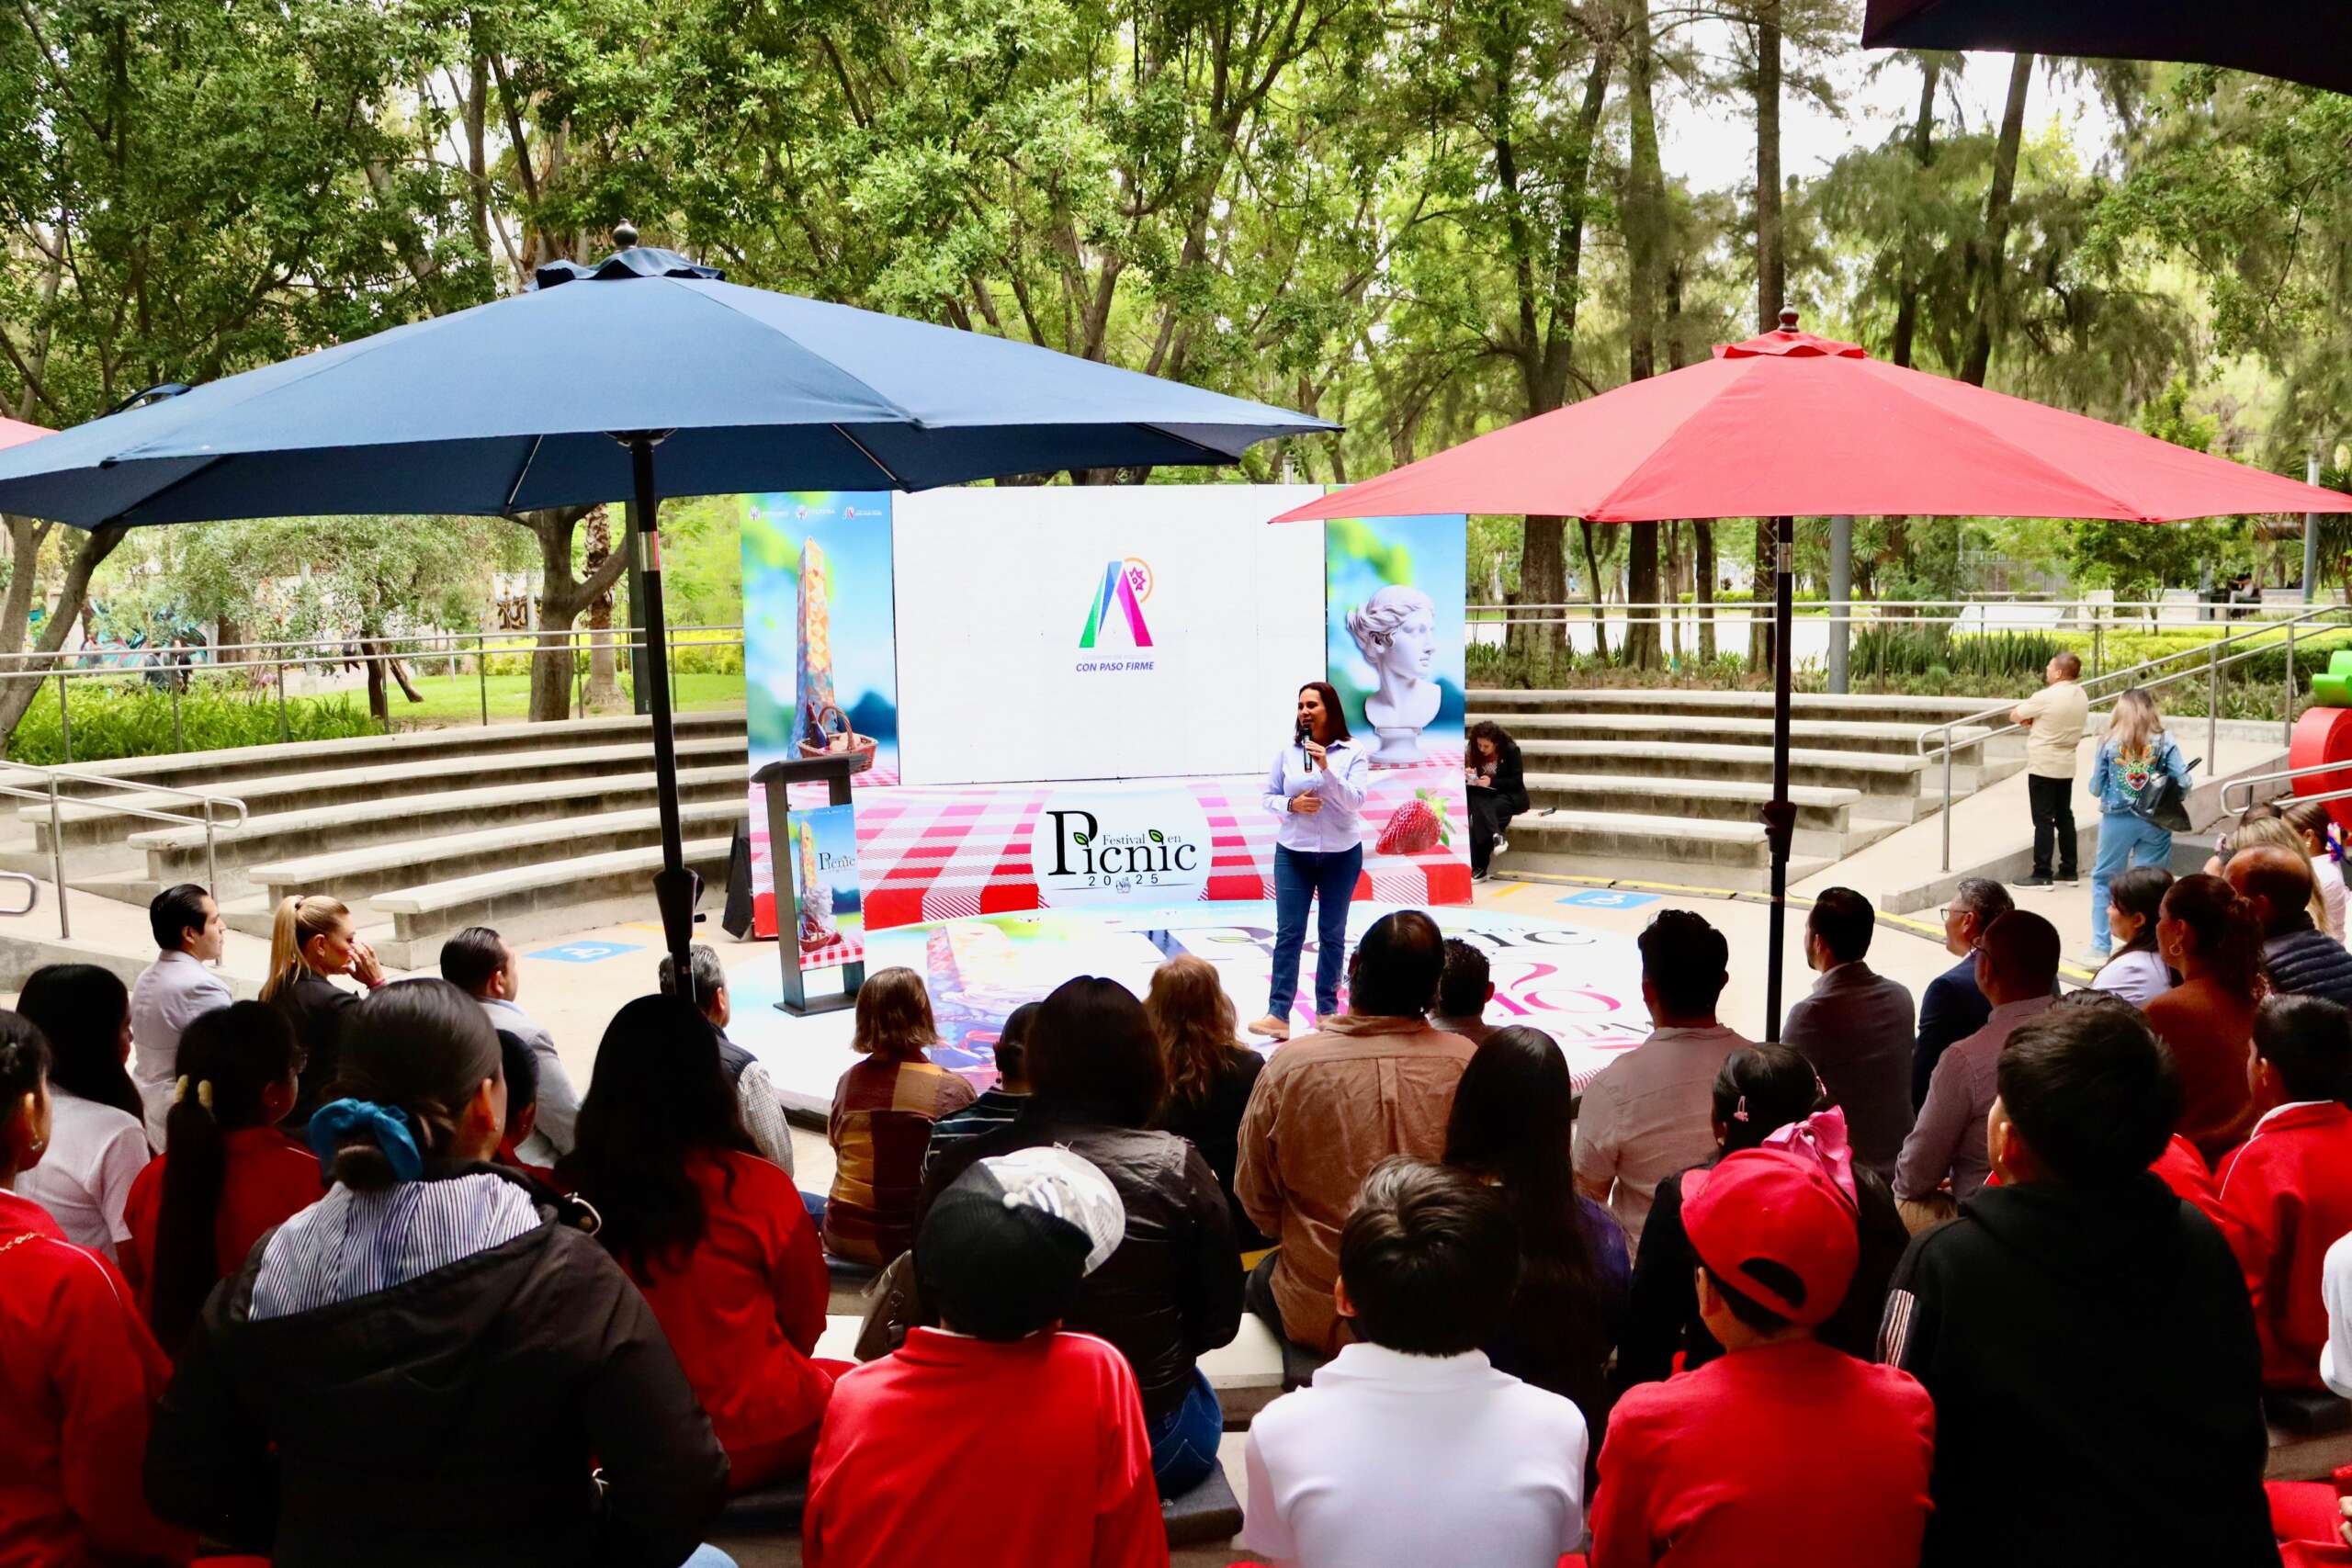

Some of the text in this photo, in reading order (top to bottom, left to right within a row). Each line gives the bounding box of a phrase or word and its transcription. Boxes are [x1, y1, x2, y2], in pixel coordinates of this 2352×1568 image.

[1076, 660, 1155, 672] CON PASO FIRME
[1046, 810, 1197, 875] Picnic
[1102, 834, 1182, 846] Festival en
